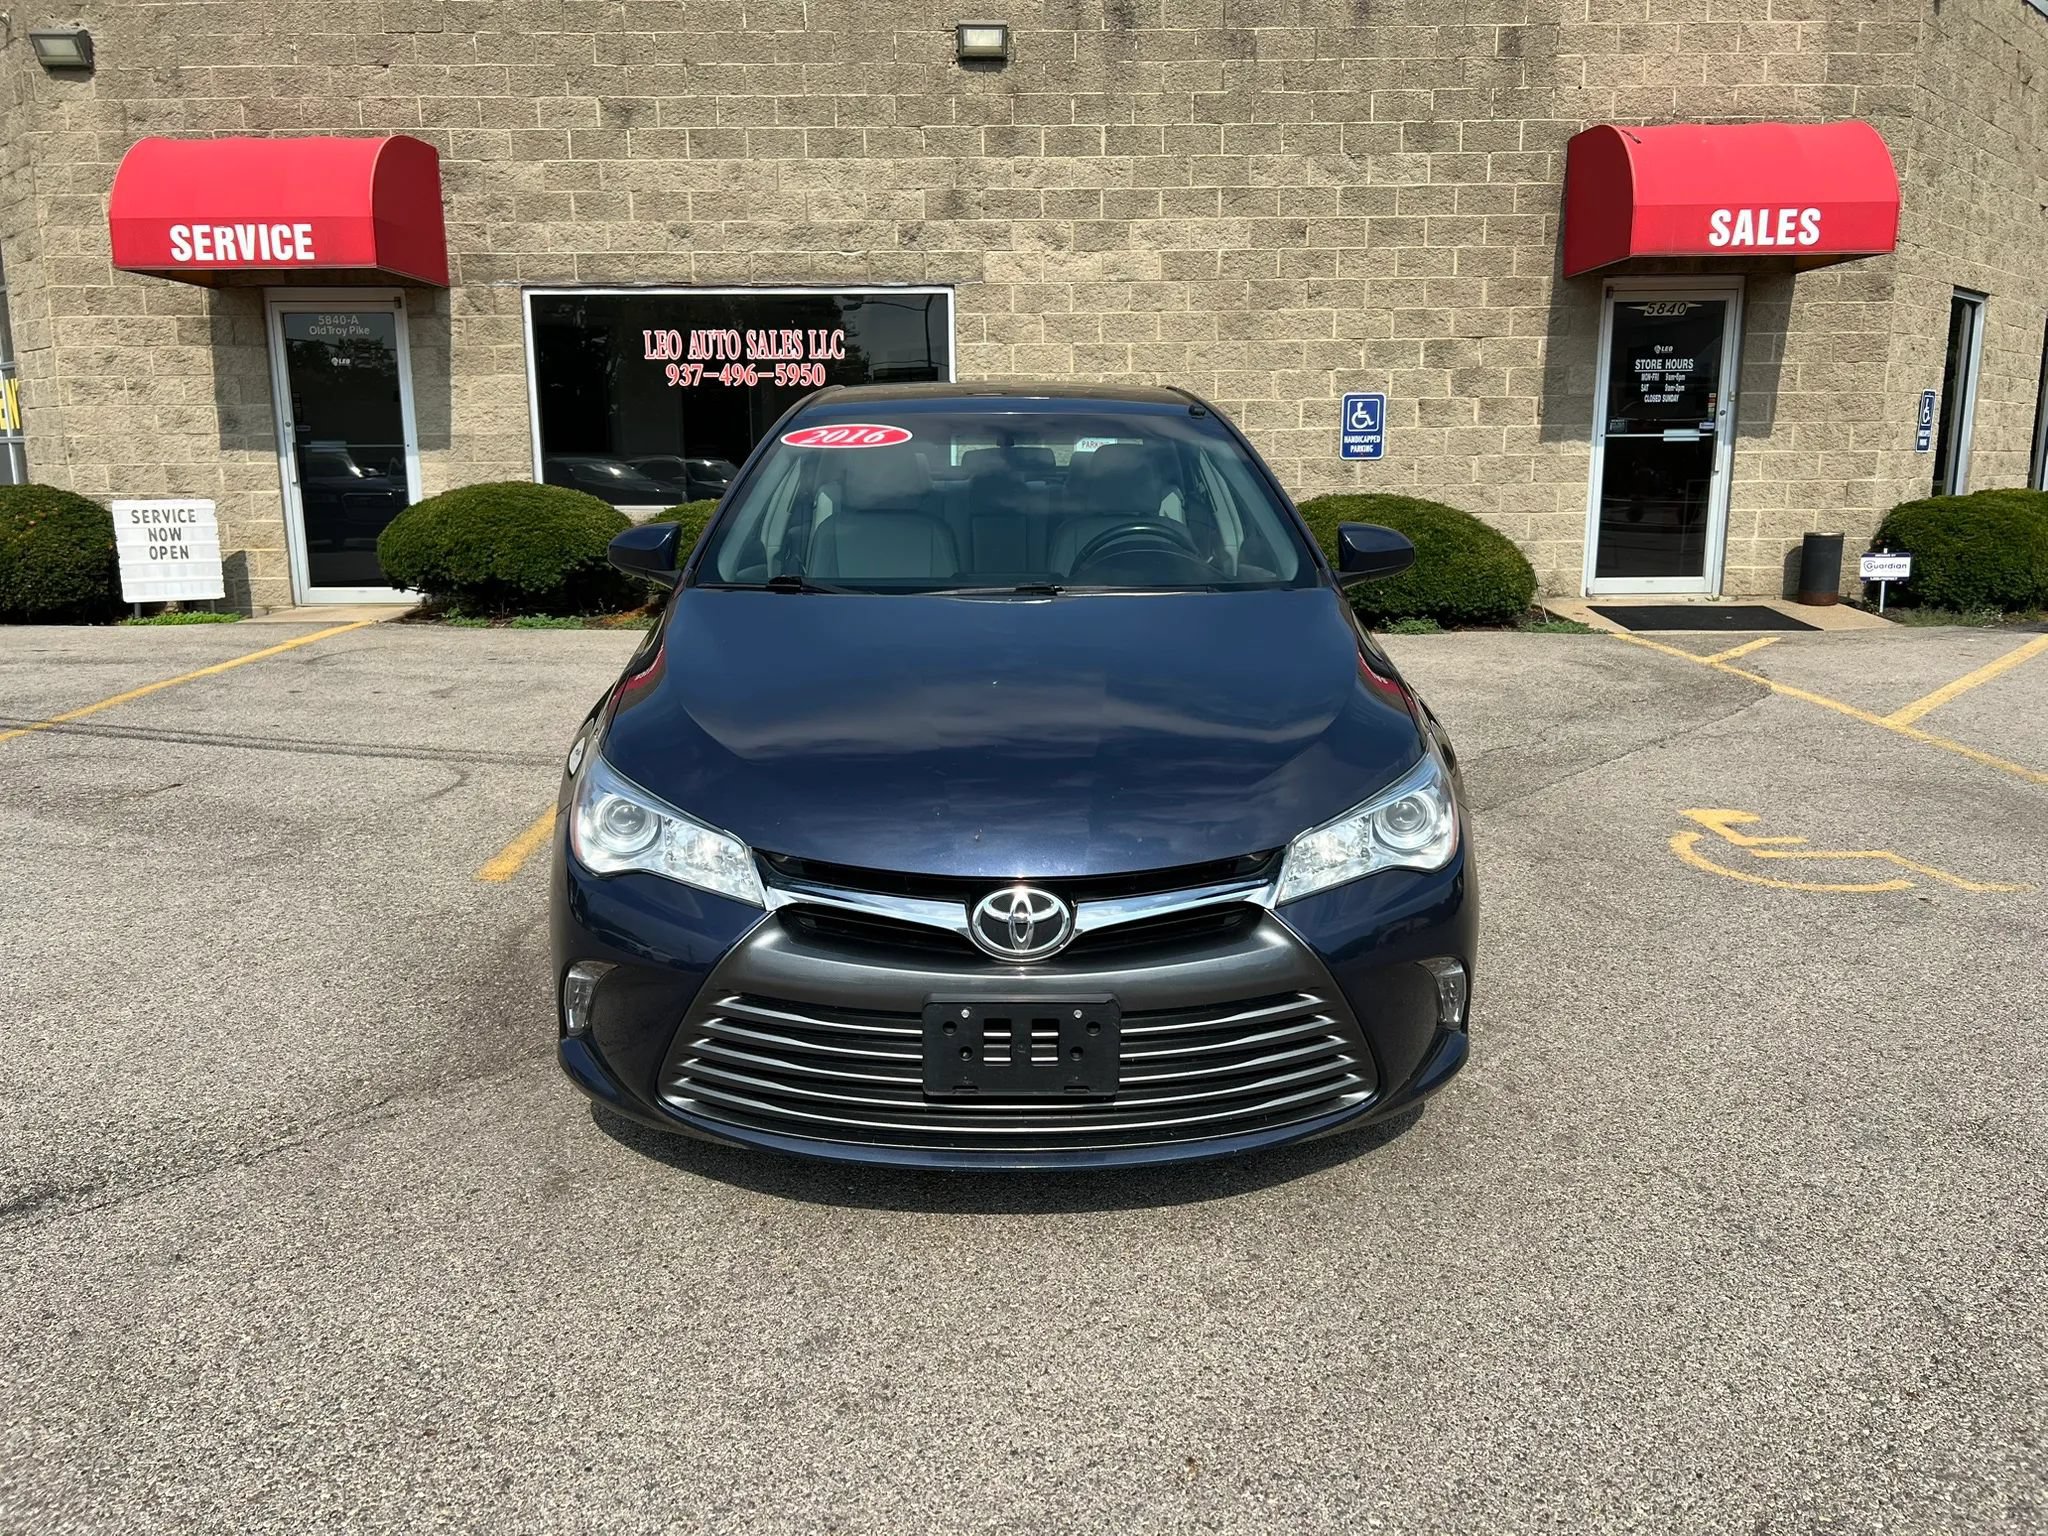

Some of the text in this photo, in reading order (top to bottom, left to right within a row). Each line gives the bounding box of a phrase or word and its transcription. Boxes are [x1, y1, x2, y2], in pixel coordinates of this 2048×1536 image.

[1708, 207, 1821, 247] SALES
[169, 223, 316, 262] SERVICE
[1646, 302, 1688, 315] 5840
[318, 315, 359, 325] 5840-A
[309, 326, 370, 336] Old Troy Pike
[643, 329, 846, 360] LEO AUTO SALES LLC
[1635, 358, 1694, 369] STORE HOURS
[665, 363, 826, 387] 937-496-5950
[1644, 394, 1661, 403] CLOSED
[797, 429, 894, 444] 2016
[1344, 435, 1381, 443] HANDICAPPED
[1350, 445, 1374, 453] PARKING
[131, 509, 196, 524] SERVICE
[148, 527, 182, 542] NOW
[149, 545, 189, 560] OPEN
[1865, 561, 1907, 570] Guardian
